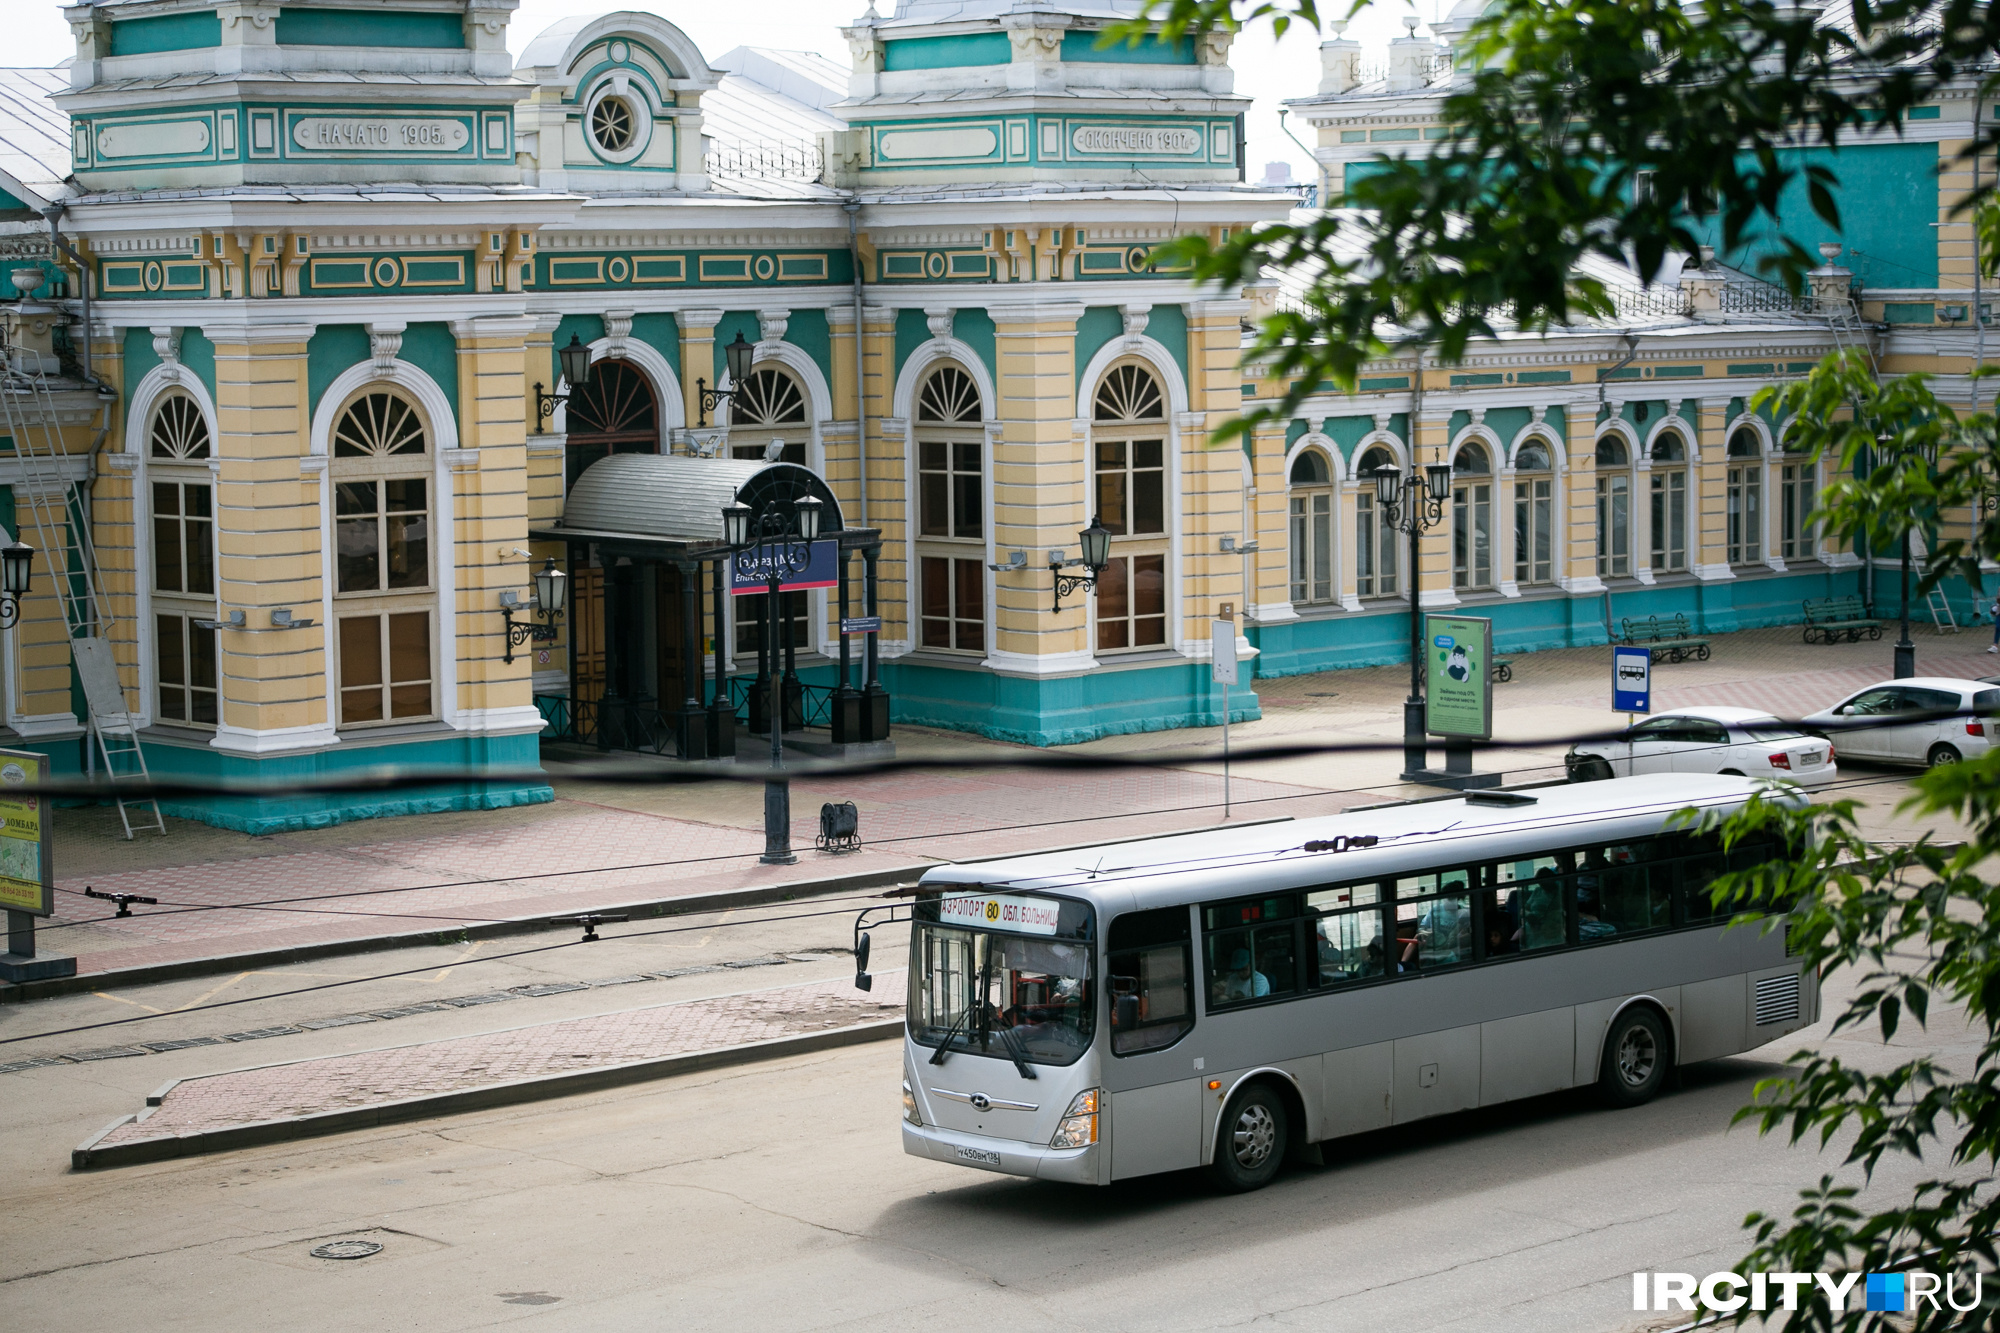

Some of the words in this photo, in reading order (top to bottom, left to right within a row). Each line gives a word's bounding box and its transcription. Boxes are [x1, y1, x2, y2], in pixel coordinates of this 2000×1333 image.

[318, 123, 390, 145] НАЧАТО
[1085, 130, 1154, 149] ОКОНЧЕНО
[6, 818, 39, 832] ЛОМБАРД
[941, 897, 985, 918] АЭРОПОРТ
[987, 903, 998, 919] 80
[1003, 904, 1019, 922] ОБЛ.
